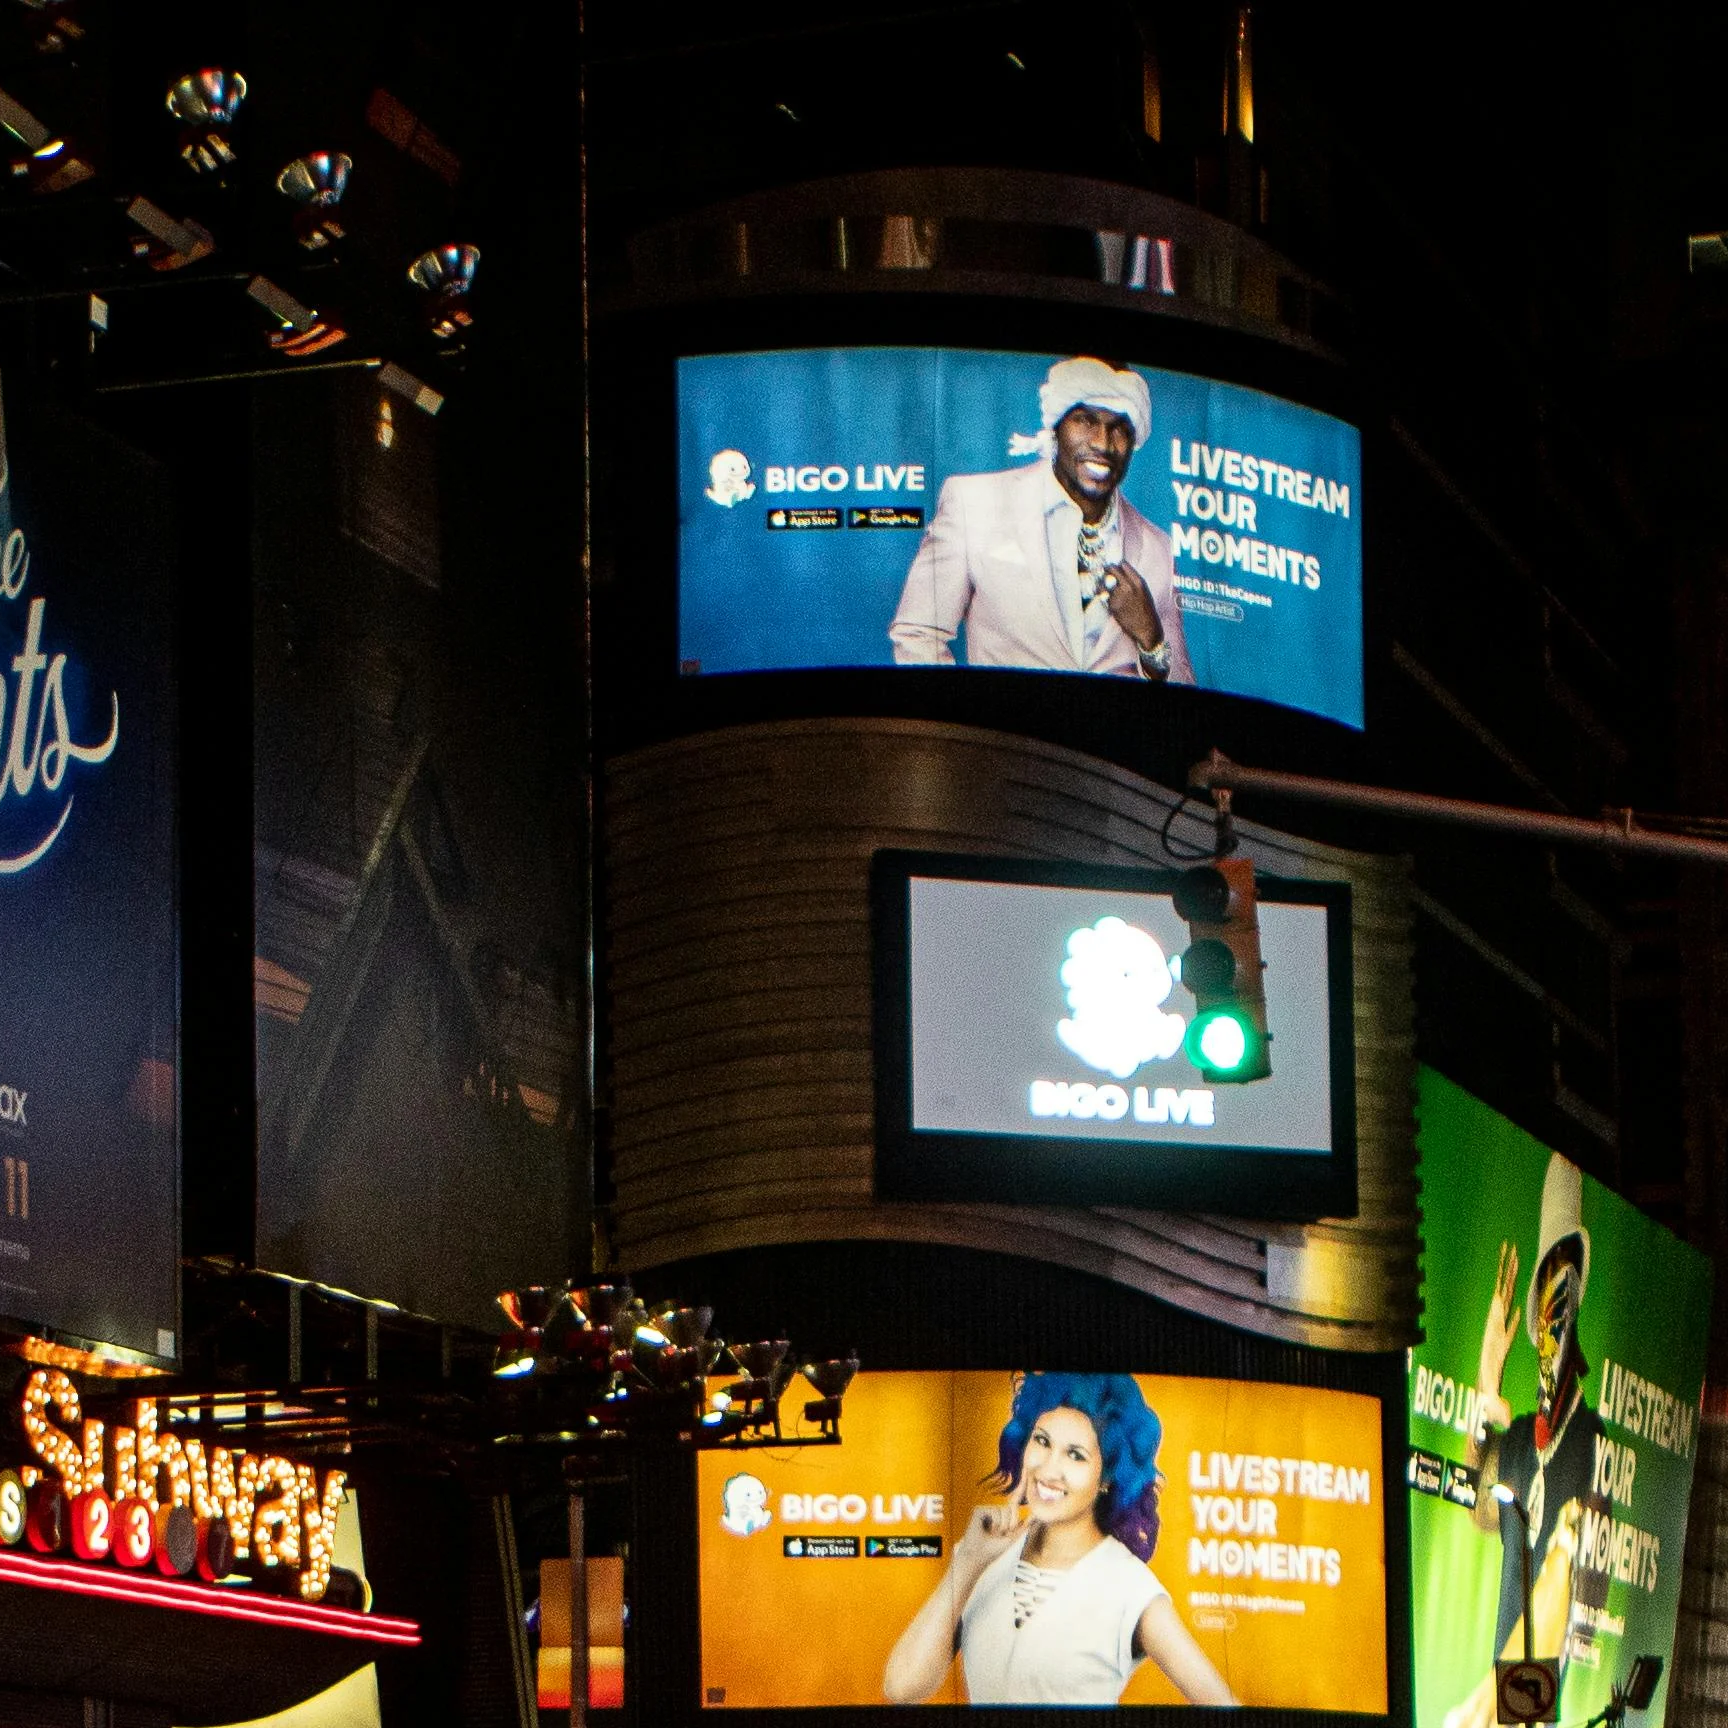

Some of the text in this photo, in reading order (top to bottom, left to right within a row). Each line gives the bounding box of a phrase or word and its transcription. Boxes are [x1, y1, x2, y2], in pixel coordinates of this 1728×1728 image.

[766, 464, 926, 494] BIGO LIVE
[1172, 438, 1352, 520] LIVESTREAM
[1173, 481, 1258, 533] YOUR
[1172, 526, 1322, 590] MOMENTS
[1030, 1080, 1215, 1126] BIGO LIVE
[2, 1157, 29, 1220] 11
[1415, 1362, 1488, 1444] BIGO LIVE
[1598, 1358, 1694, 1458] LIVESTREAM
[1188, 1451, 1370, 1504] LIVESTREAM
[1592, 1432, 1637, 1507] YOUR
[781, 1493, 944, 1522] BIGO LIVE
[1189, 1496, 1277, 1537] YOUR
[807, 1544, 855, 1557] App Store
[888, 1545, 939, 1558] Google Play
[1188, 1538, 1341, 1586] MOMENTS
[1579, 1505, 1660, 1593] MOMENTS
